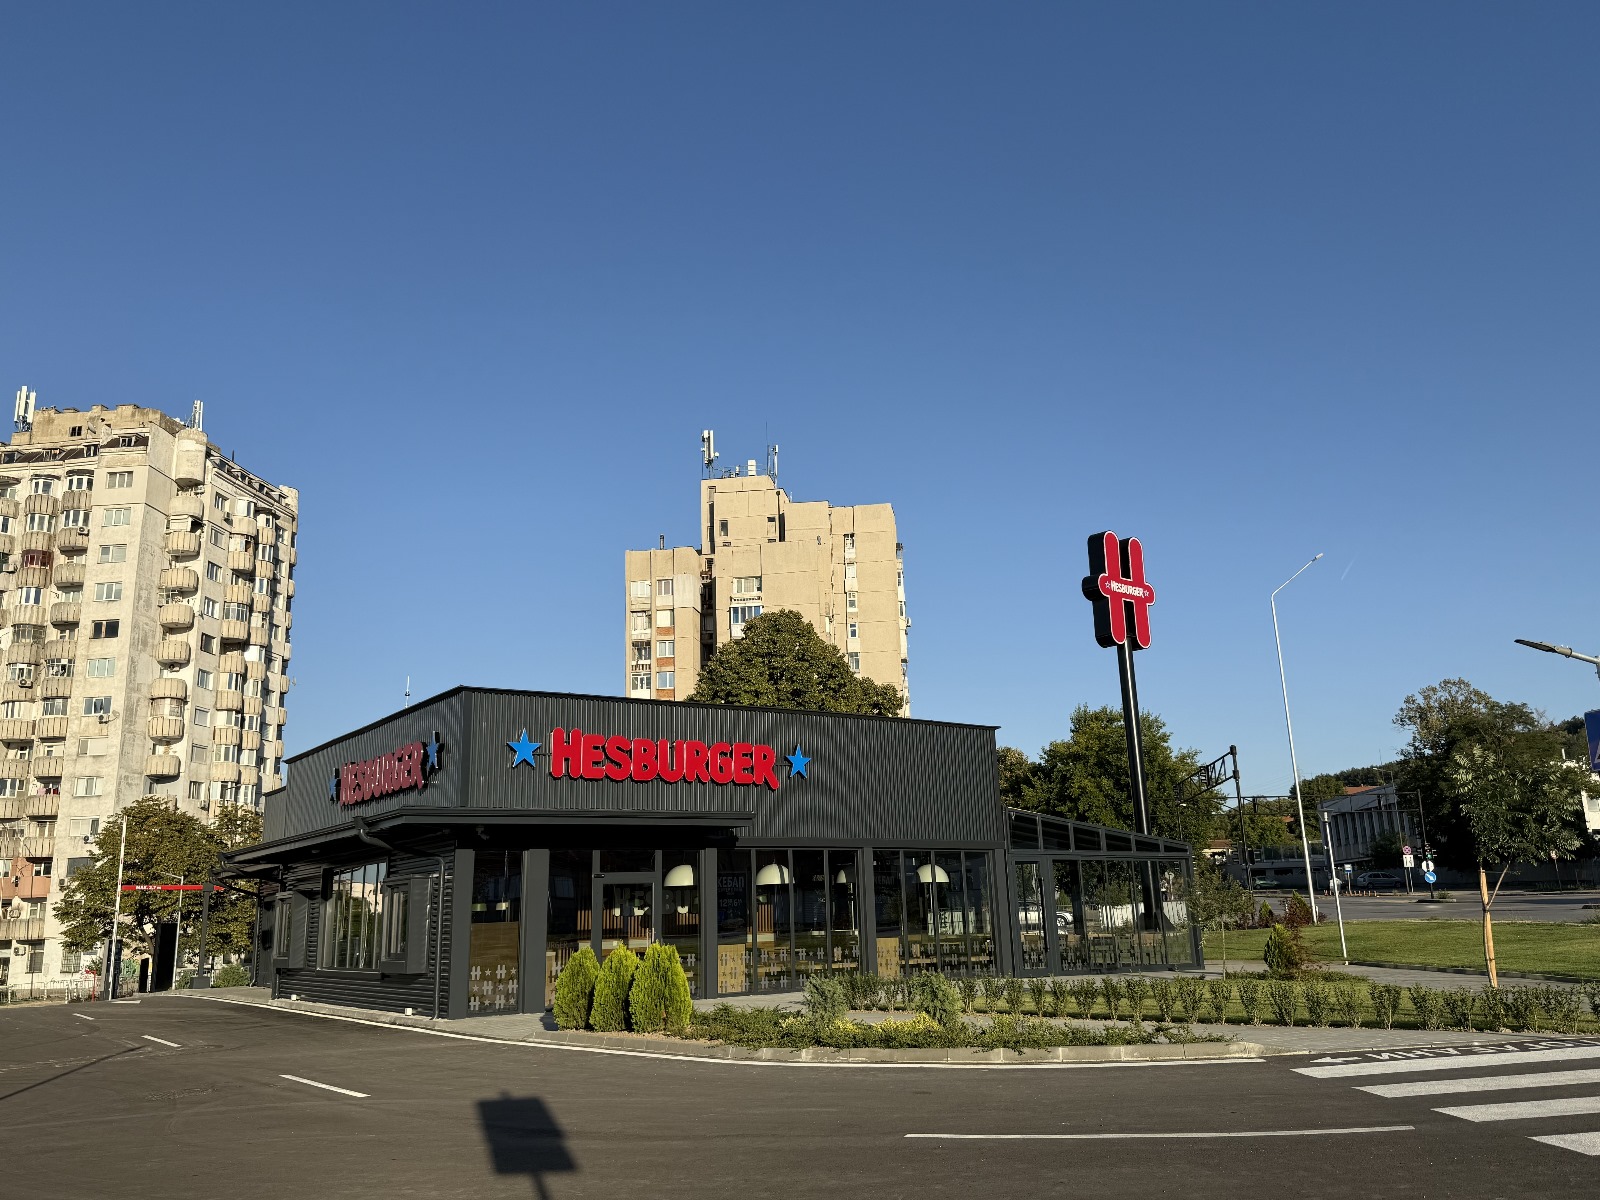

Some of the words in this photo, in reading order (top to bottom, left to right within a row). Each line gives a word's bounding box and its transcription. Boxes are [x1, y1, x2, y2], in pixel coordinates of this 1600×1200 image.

[1110, 580, 1145, 598] HESBURGER
[340, 741, 423, 806] HESBURGER
[551, 727, 779, 789] HESBURGER
